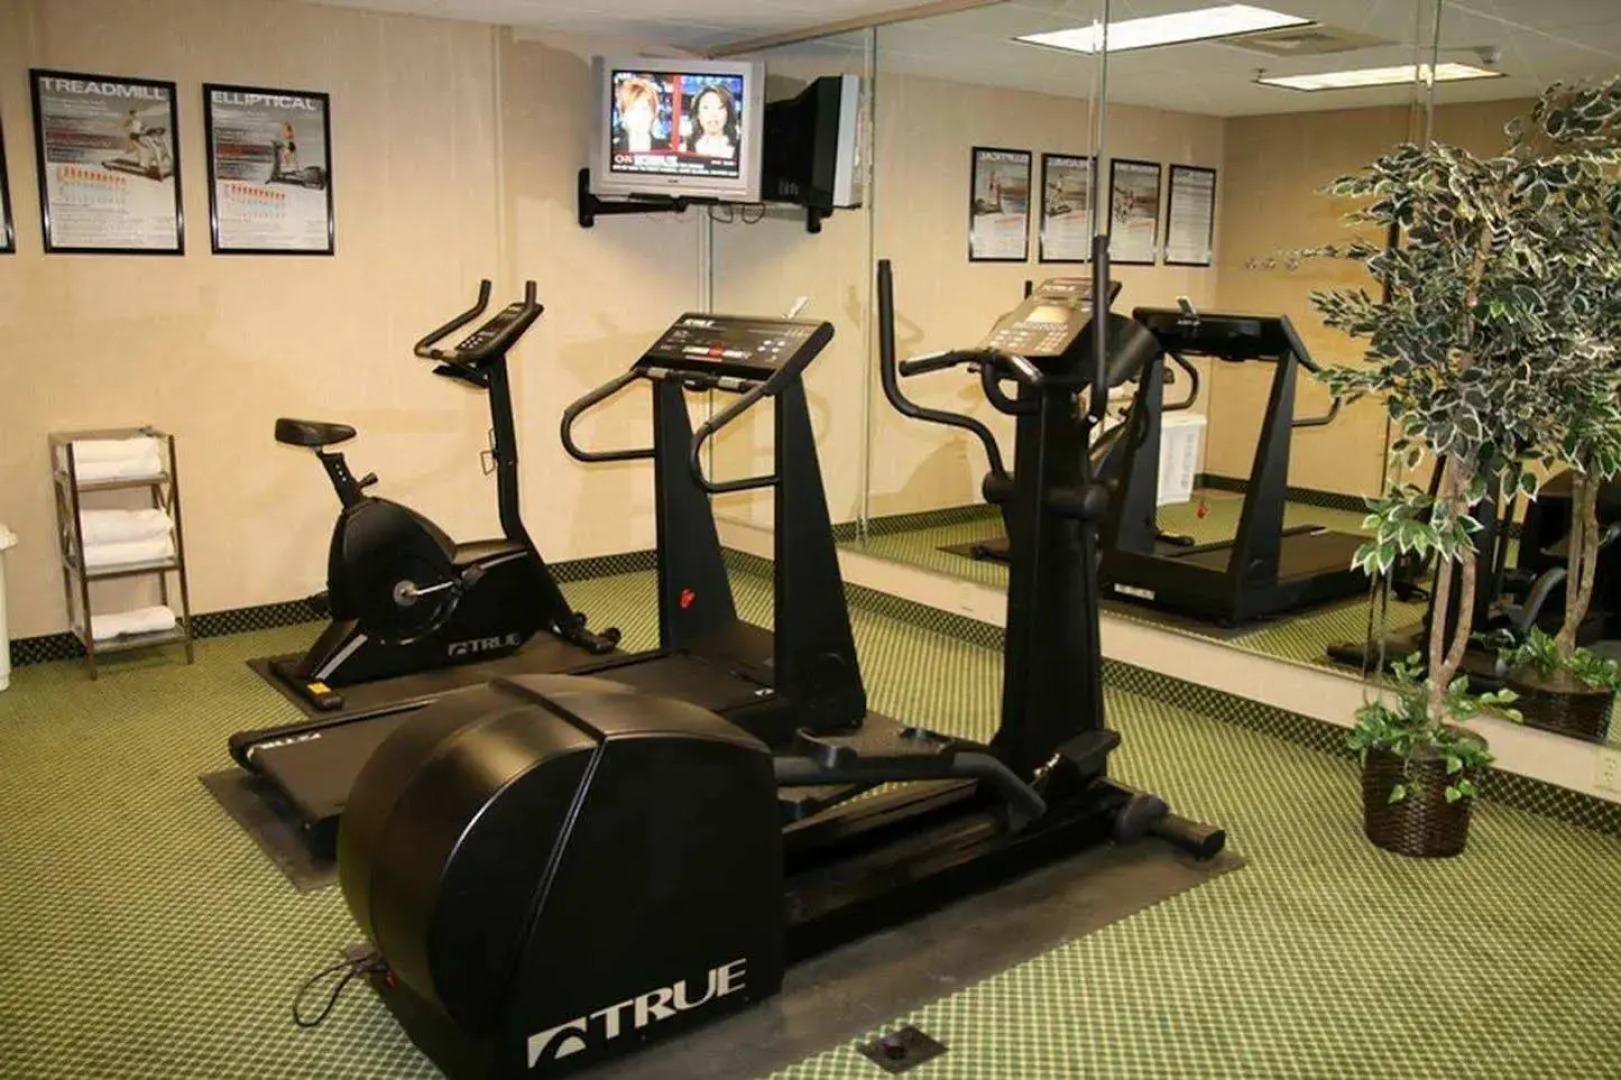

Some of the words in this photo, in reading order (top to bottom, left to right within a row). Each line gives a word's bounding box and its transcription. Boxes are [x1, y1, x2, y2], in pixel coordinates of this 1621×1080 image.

[38, 76, 166, 100] TREADMILL
[211, 90, 317, 111] ELLIPTICAL
[468, 632, 521, 652] TRUE
[589, 957, 747, 1040] TRUE
